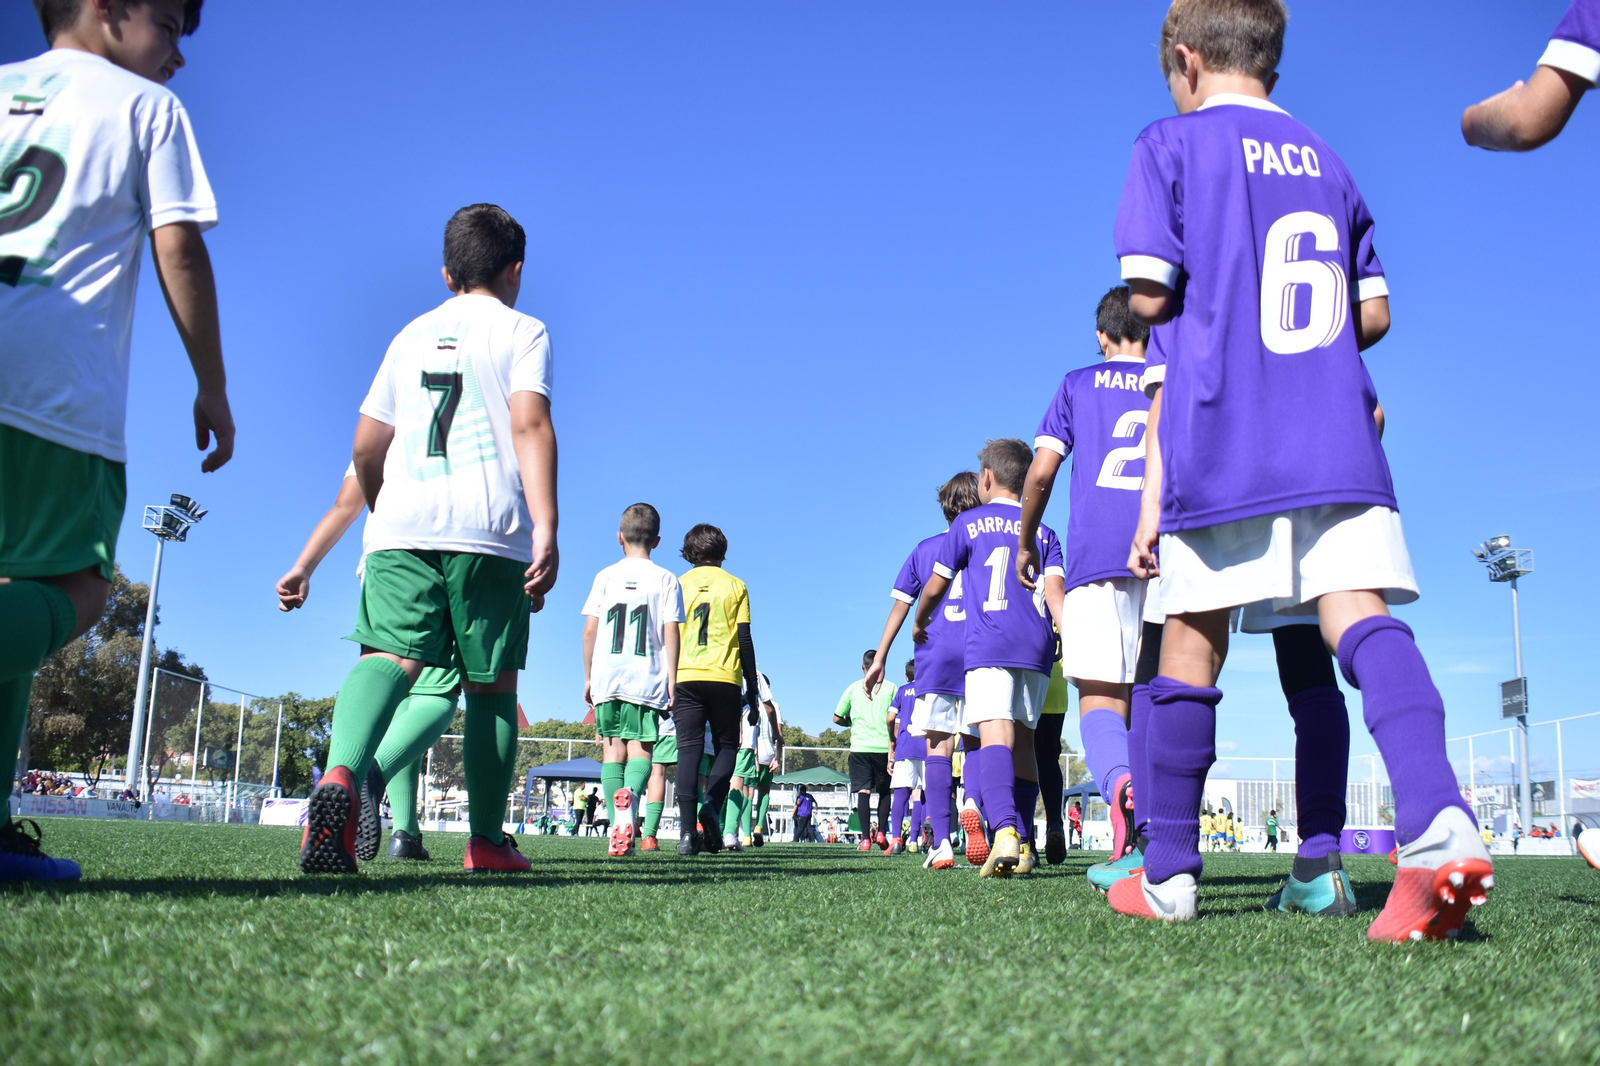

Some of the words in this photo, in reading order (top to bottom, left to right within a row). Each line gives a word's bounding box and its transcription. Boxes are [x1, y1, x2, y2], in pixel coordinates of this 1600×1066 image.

[1242, 138, 1321, 177] PACO
[1260, 211, 1347, 354] 6
[421, 370, 463, 460] 7
[1095, 410, 1149, 491] 2
[606, 602, 649, 657] 11
[693, 602, 711, 646] 1
[31, 798, 88, 815] NISSAN
